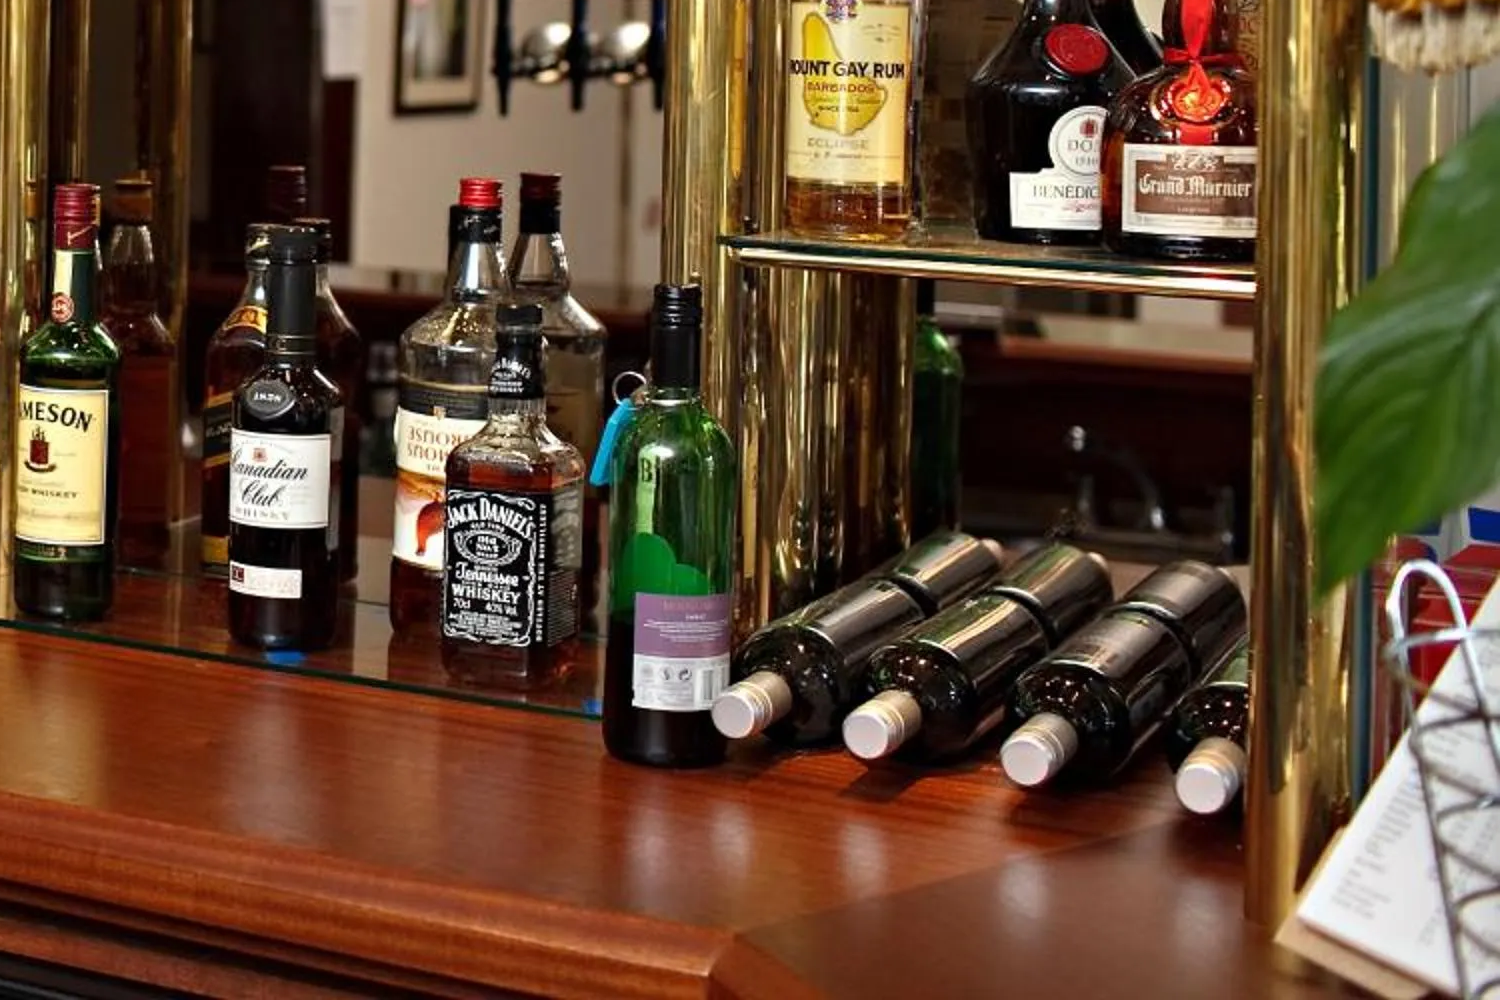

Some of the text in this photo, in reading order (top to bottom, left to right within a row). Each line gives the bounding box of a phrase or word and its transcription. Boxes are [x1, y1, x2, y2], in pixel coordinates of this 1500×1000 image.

[832, 60, 868, 78] GAY
[872, 61, 905, 80] RUM
[1140, 173, 1253, 198] Grand Marnier
[231, 450, 308, 481] Canadian
[240, 480, 283, 508] Club
[448, 497, 536, 539] JACK DANIEL'S
[455, 561, 519, 587] Tennessee
